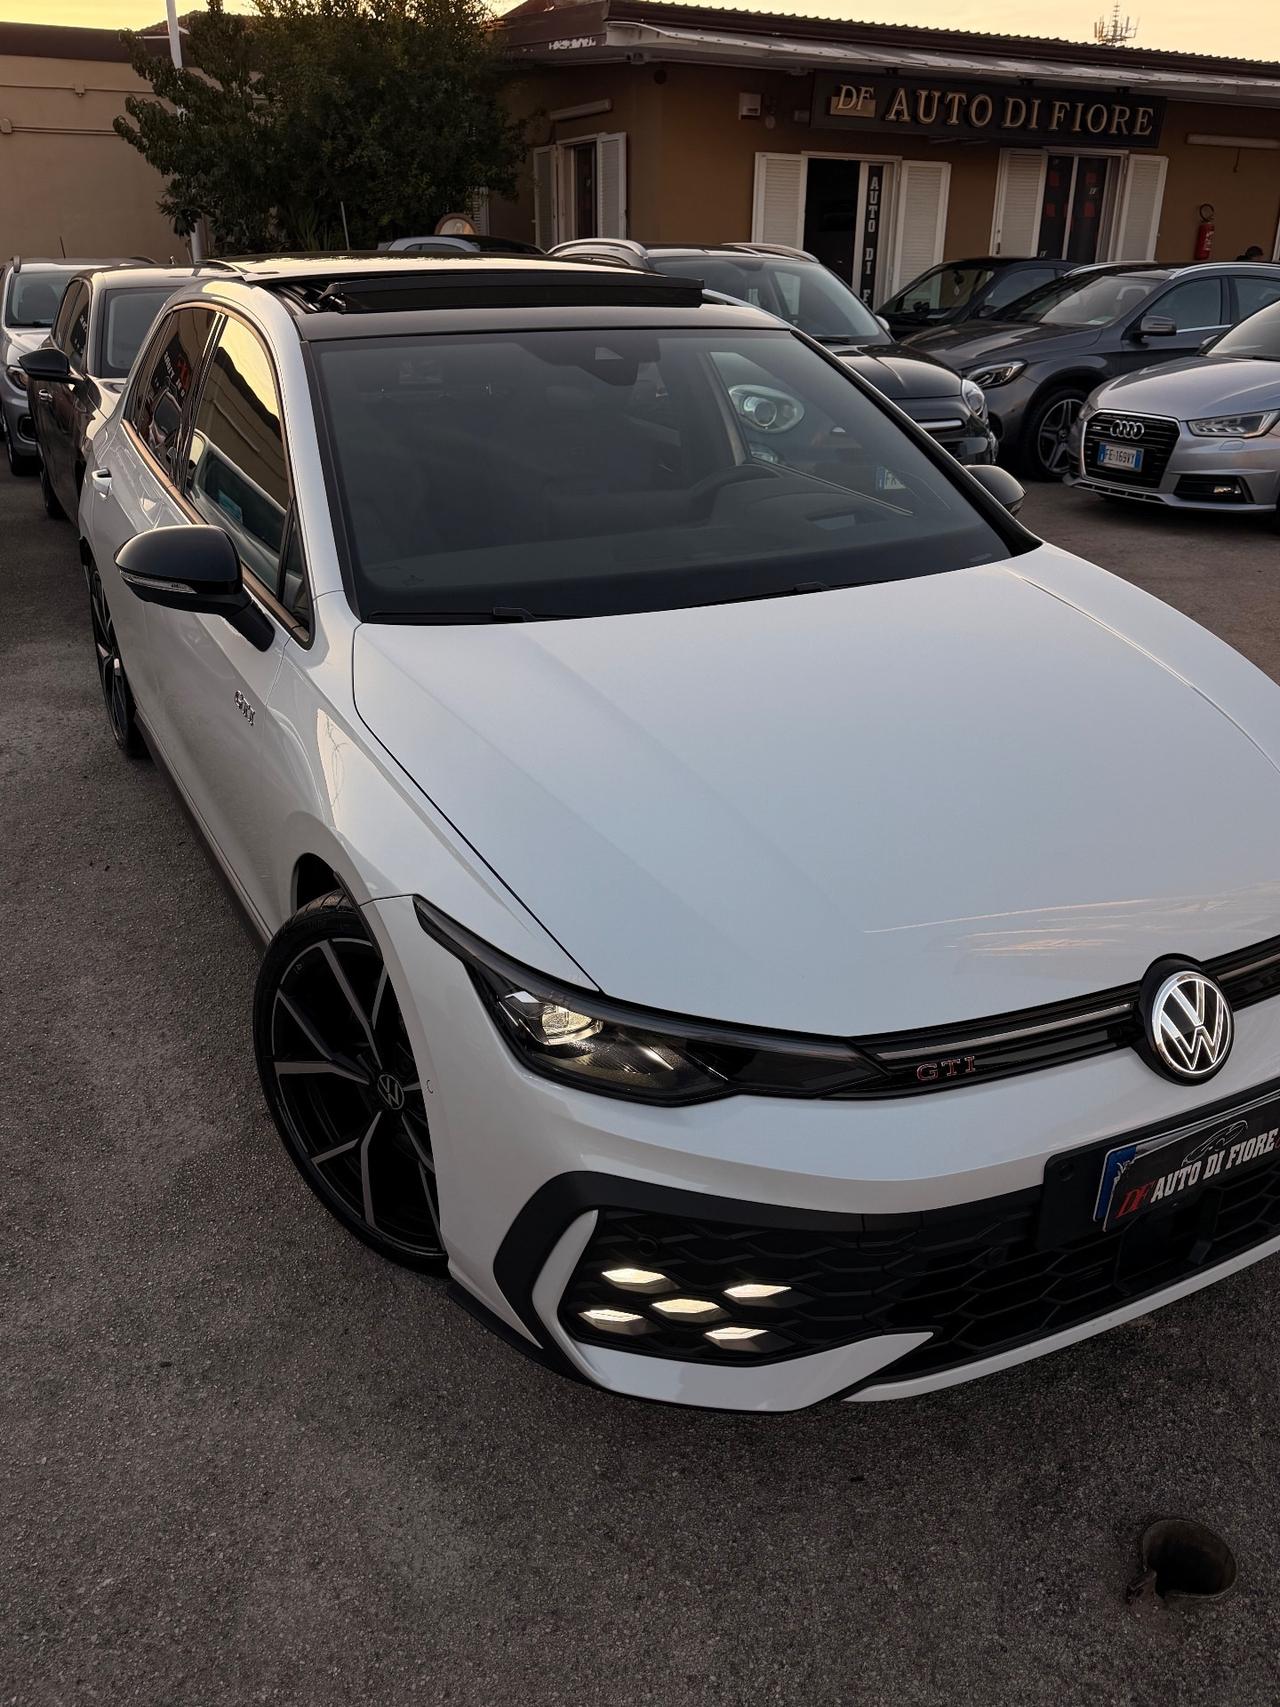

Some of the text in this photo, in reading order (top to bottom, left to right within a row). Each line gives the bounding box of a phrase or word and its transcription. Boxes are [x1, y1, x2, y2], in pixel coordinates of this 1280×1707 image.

[836, 84, 1154, 136] DF AUTO DI FIORE
[865, 176, 880, 275] AUTO DI
[916, 1055, 976, 1081] GTI
[1150, 1160, 1202, 1204] AUTO
[1202, 1149, 1226, 1181] DI
[1225, 1127, 1279, 1171] FIORE
